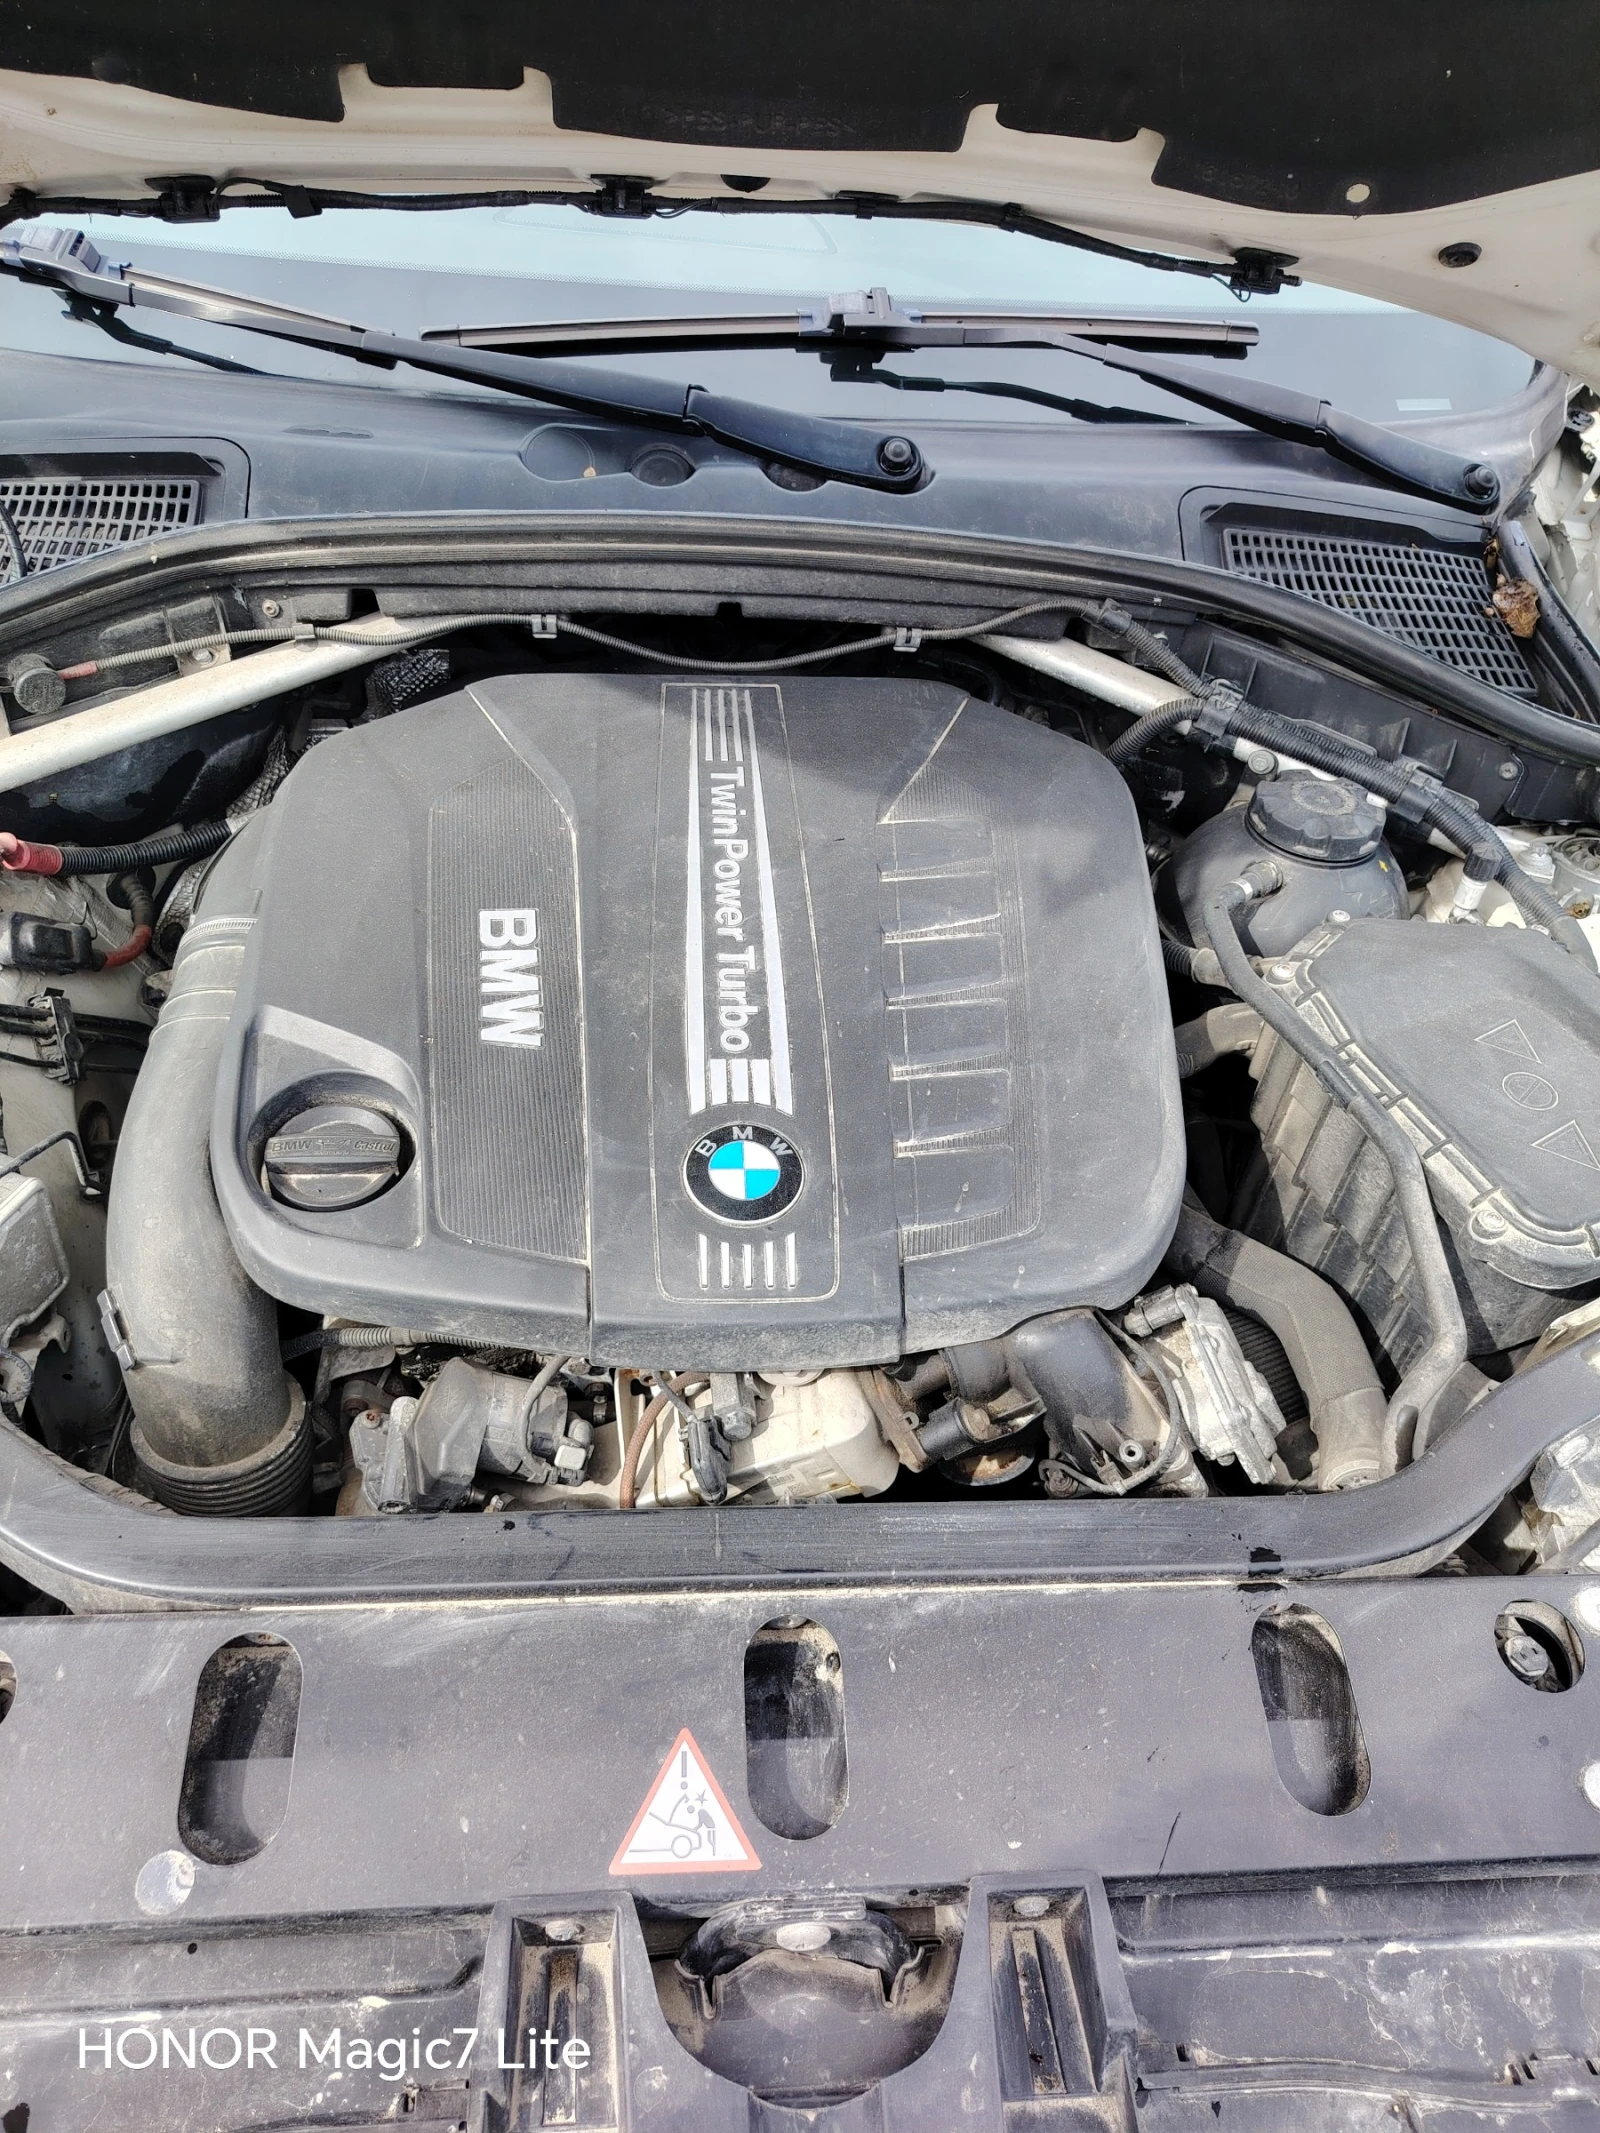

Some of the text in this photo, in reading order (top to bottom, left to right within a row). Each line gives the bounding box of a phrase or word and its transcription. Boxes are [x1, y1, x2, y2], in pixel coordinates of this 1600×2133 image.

[710, 766, 760, 1053] TwinPower Turbo
[479, 908, 544, 1048] BMW
[272, 1139, 396, 1152] BMW Castrol
[694, 1125, 794, 1158] BMW
